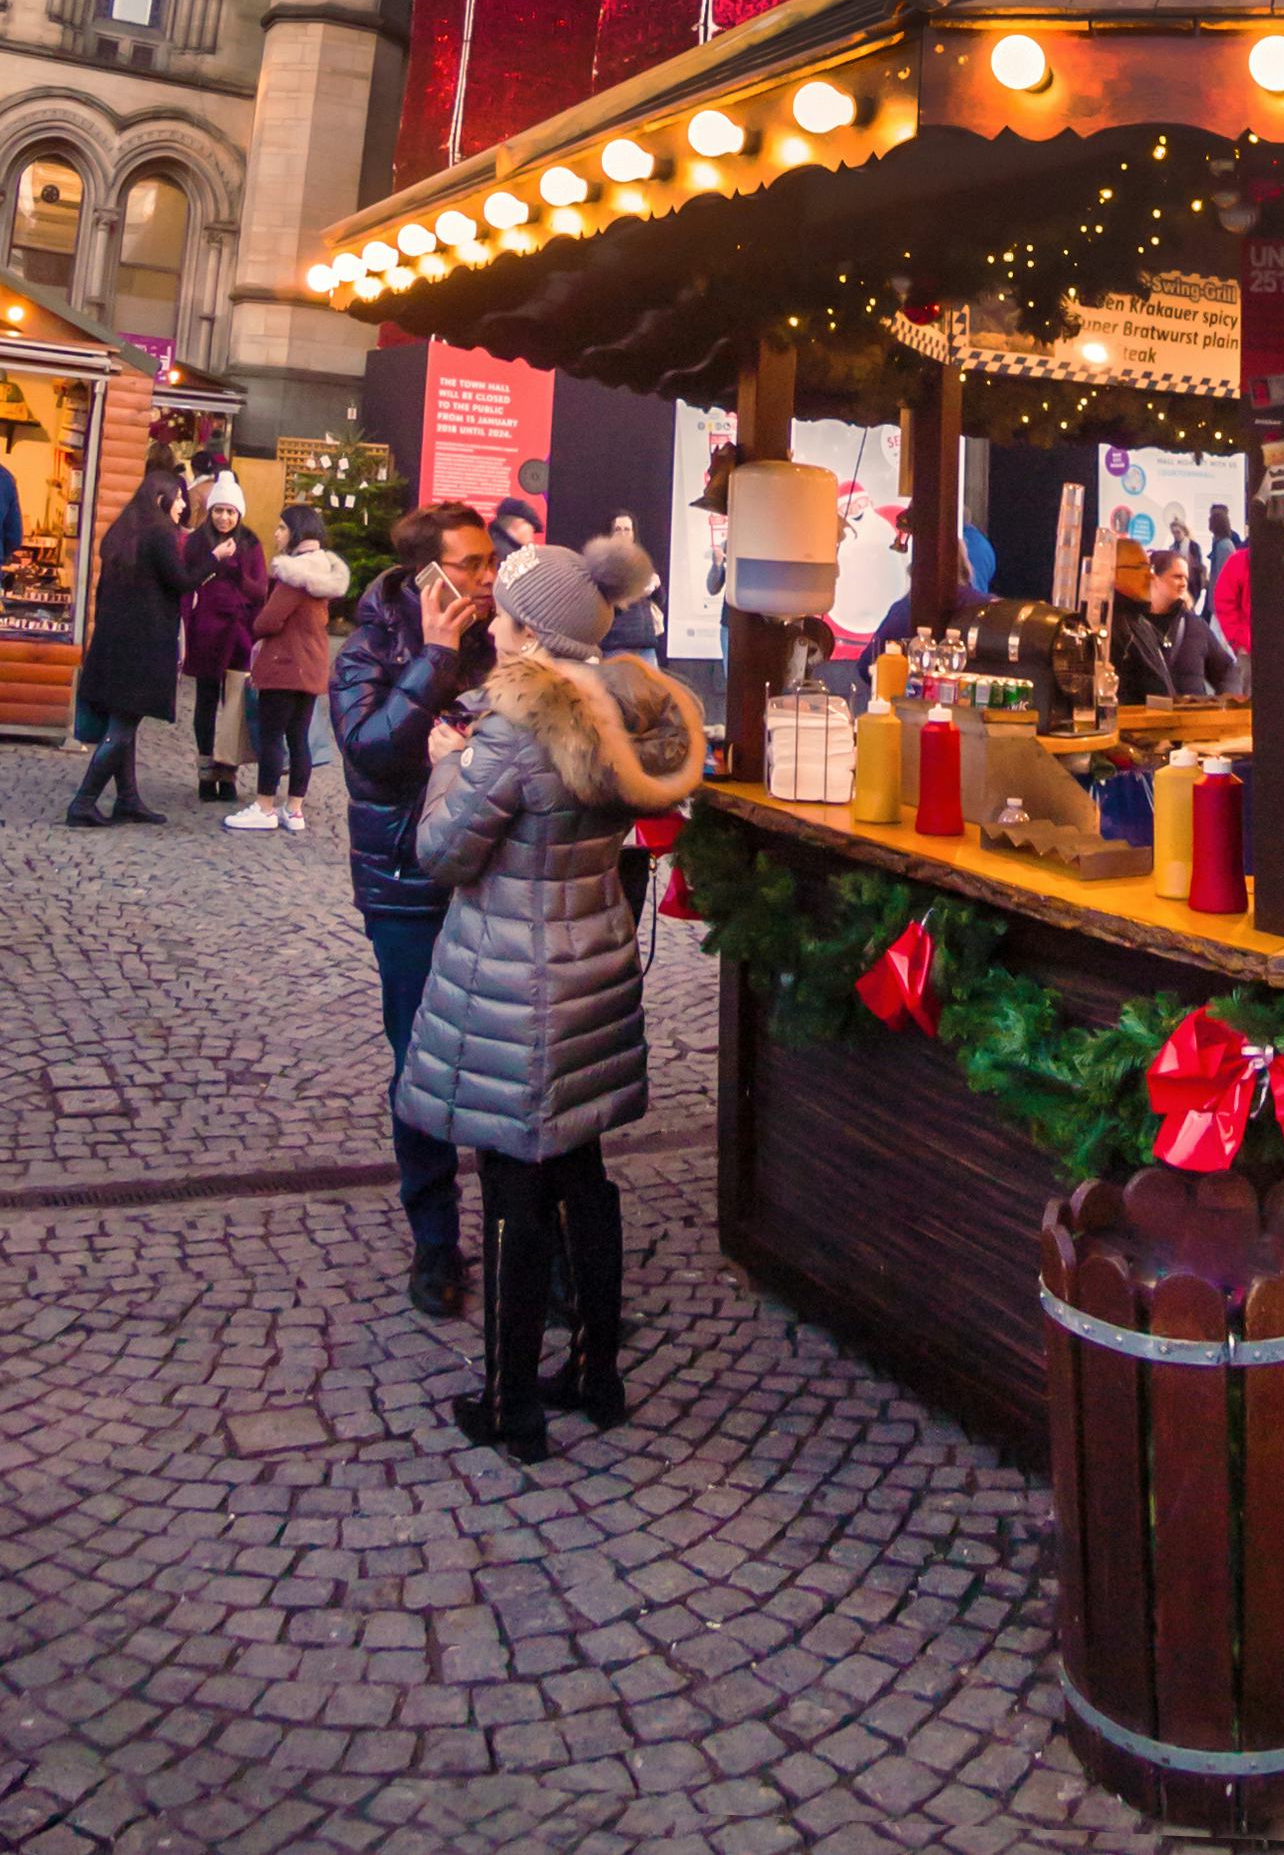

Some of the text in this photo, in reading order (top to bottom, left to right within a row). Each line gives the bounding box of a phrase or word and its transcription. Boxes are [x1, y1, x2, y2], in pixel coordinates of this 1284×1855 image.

[1130, 296, 1199, 322] Krakauer
[1202, 309, 1239, 331] spicy
[1079, 318, 1240, 351] uper Bratwurst plain
[1123, 345, 1158, 365] teak
[439, 376, 511, 393] THE TOWN HALL
[438, 389, 511, 405] WILL BE CLOSED
[437, 400, 504, 415] TO THE PUBLIC
[437, 412, 464, 423] FROM
[477, 416, 519, 428] JANUARY
[436, 423, 457, 434] 2018
[459, 425, 486, 437] UNTIL
